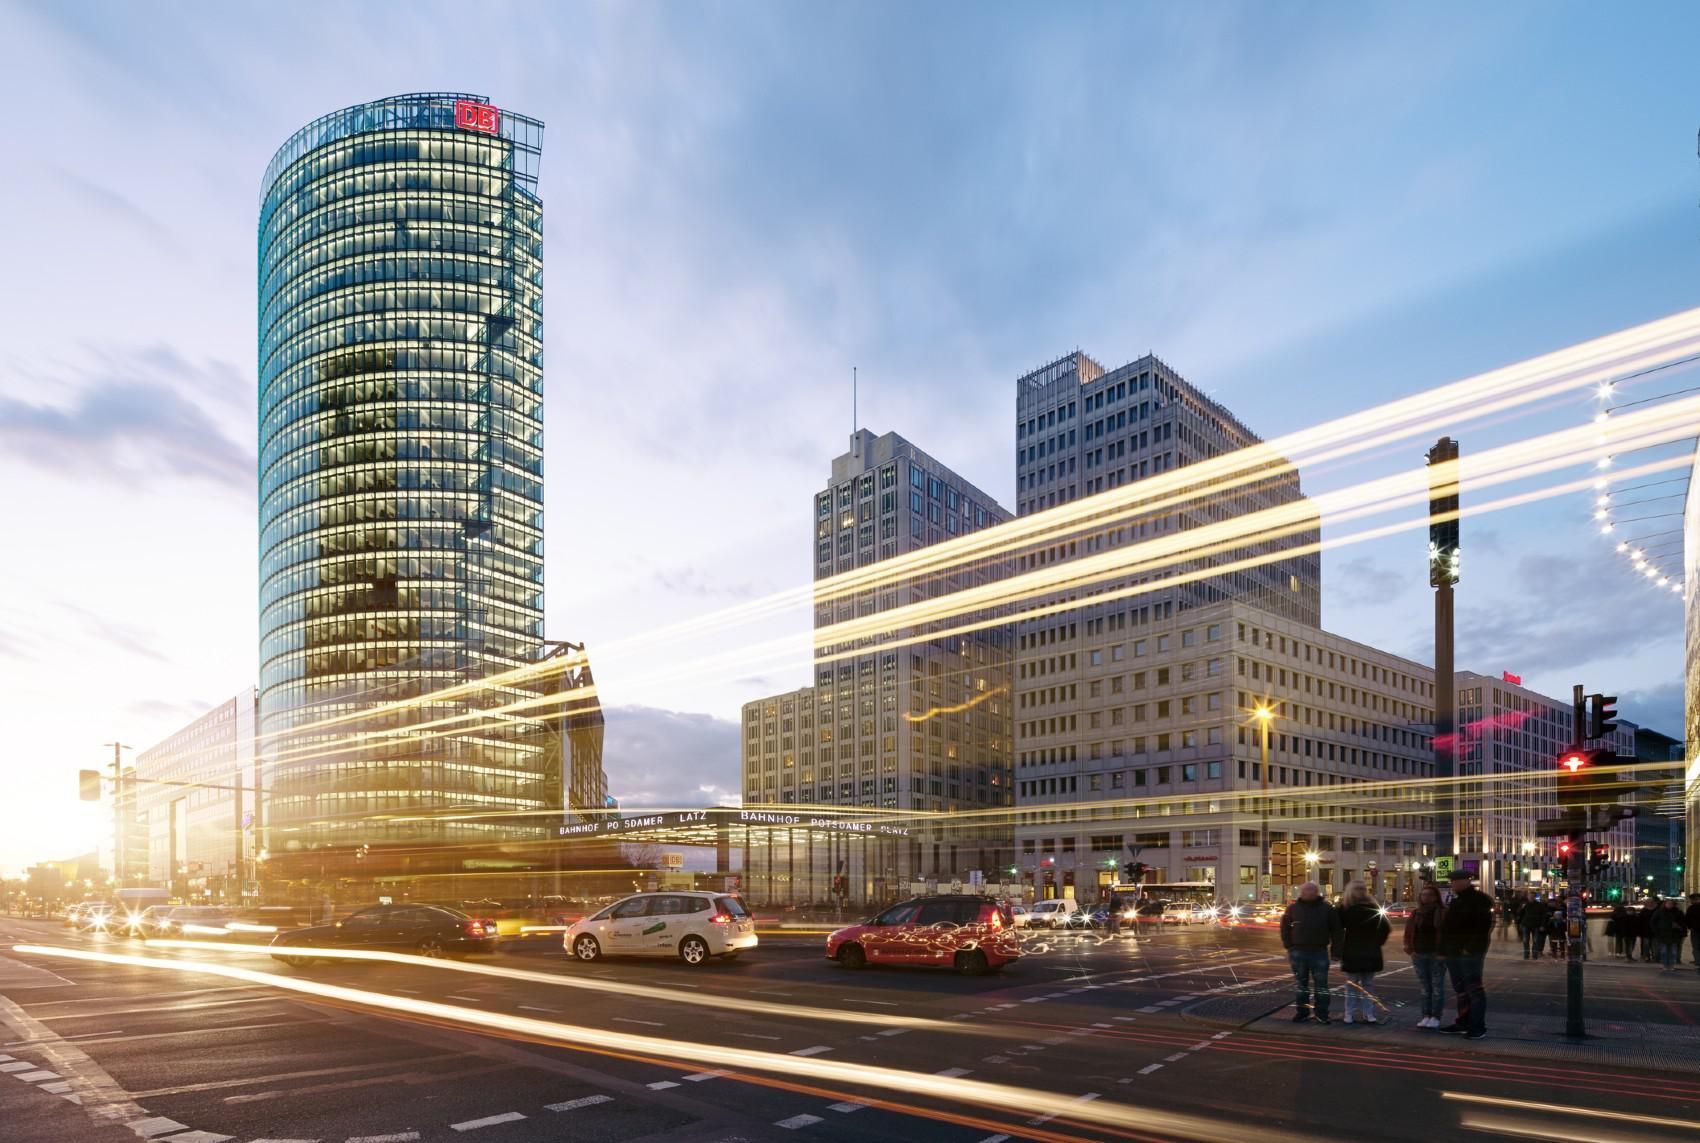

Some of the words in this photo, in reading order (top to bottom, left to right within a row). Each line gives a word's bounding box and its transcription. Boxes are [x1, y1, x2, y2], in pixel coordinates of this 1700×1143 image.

[460, 104, 495, 129] DB
[559, 822, 600, 836] BAHNHOF
[607, 815, 664, 830] POSDAMER
[740, 810, 800, 825] BAHNHOF
[810, 817, 873, 832] POTSDAMER
